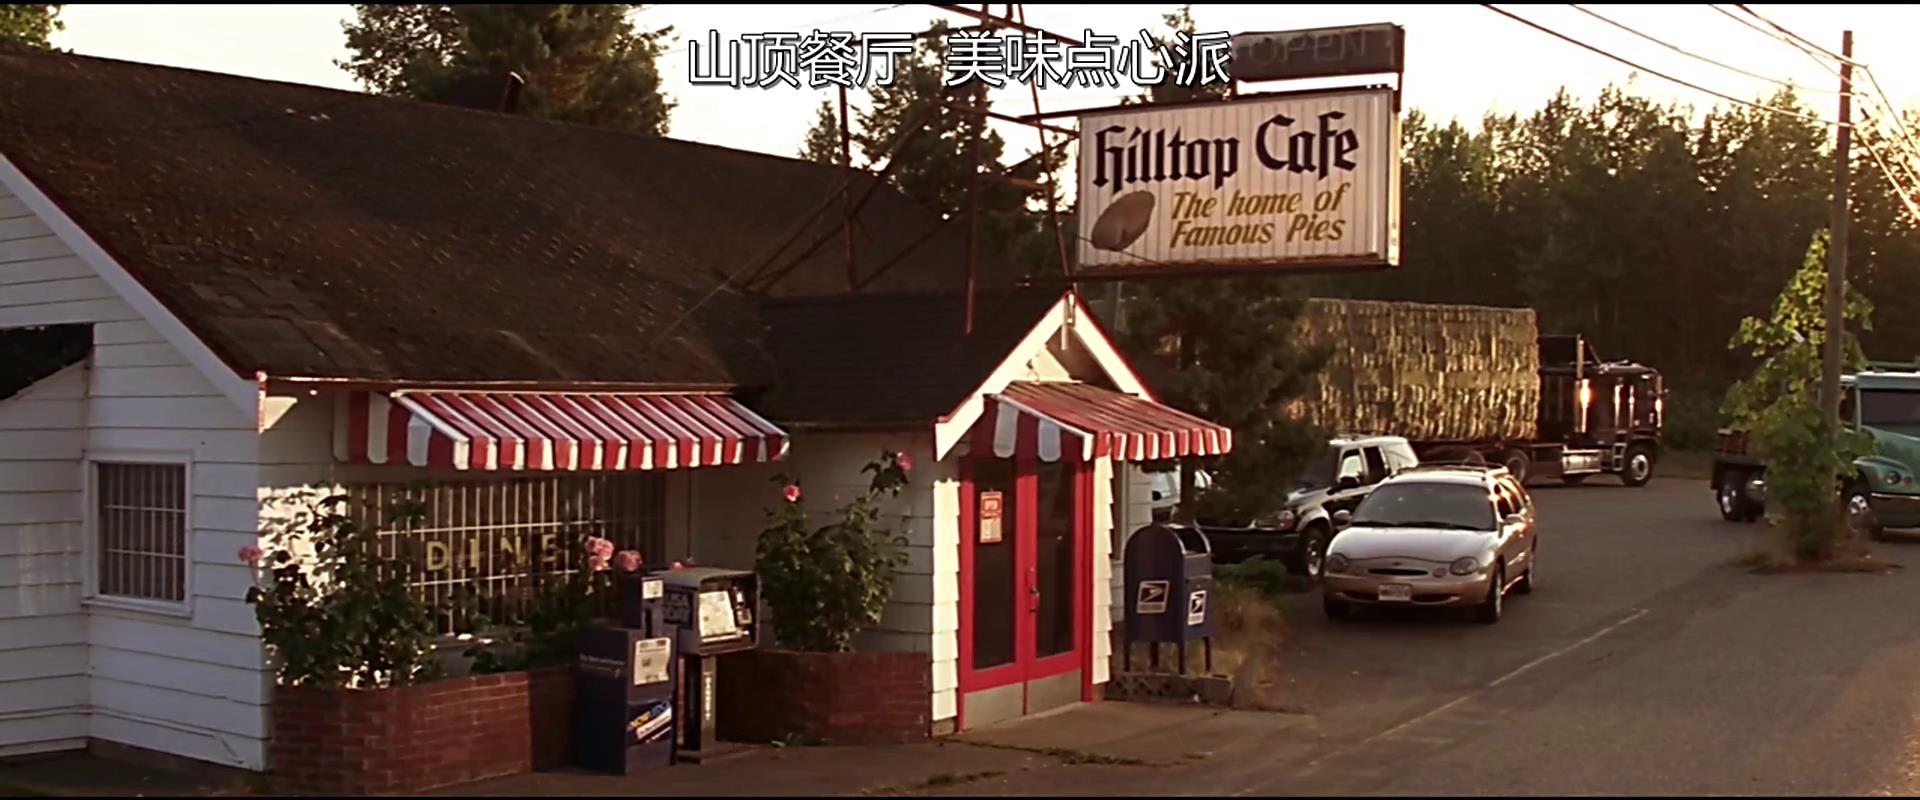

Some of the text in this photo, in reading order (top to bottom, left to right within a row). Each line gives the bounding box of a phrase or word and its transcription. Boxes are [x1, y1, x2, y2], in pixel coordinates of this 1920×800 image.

[1249, 29, 1366, 64] OPEN
[1255, 111, 1359, 181] Cafe
[1172, 182, 1351, 219] The home of
[1170, 214, 1346, 248] Famous Pies
[426, 533, 588, 572] DINE
